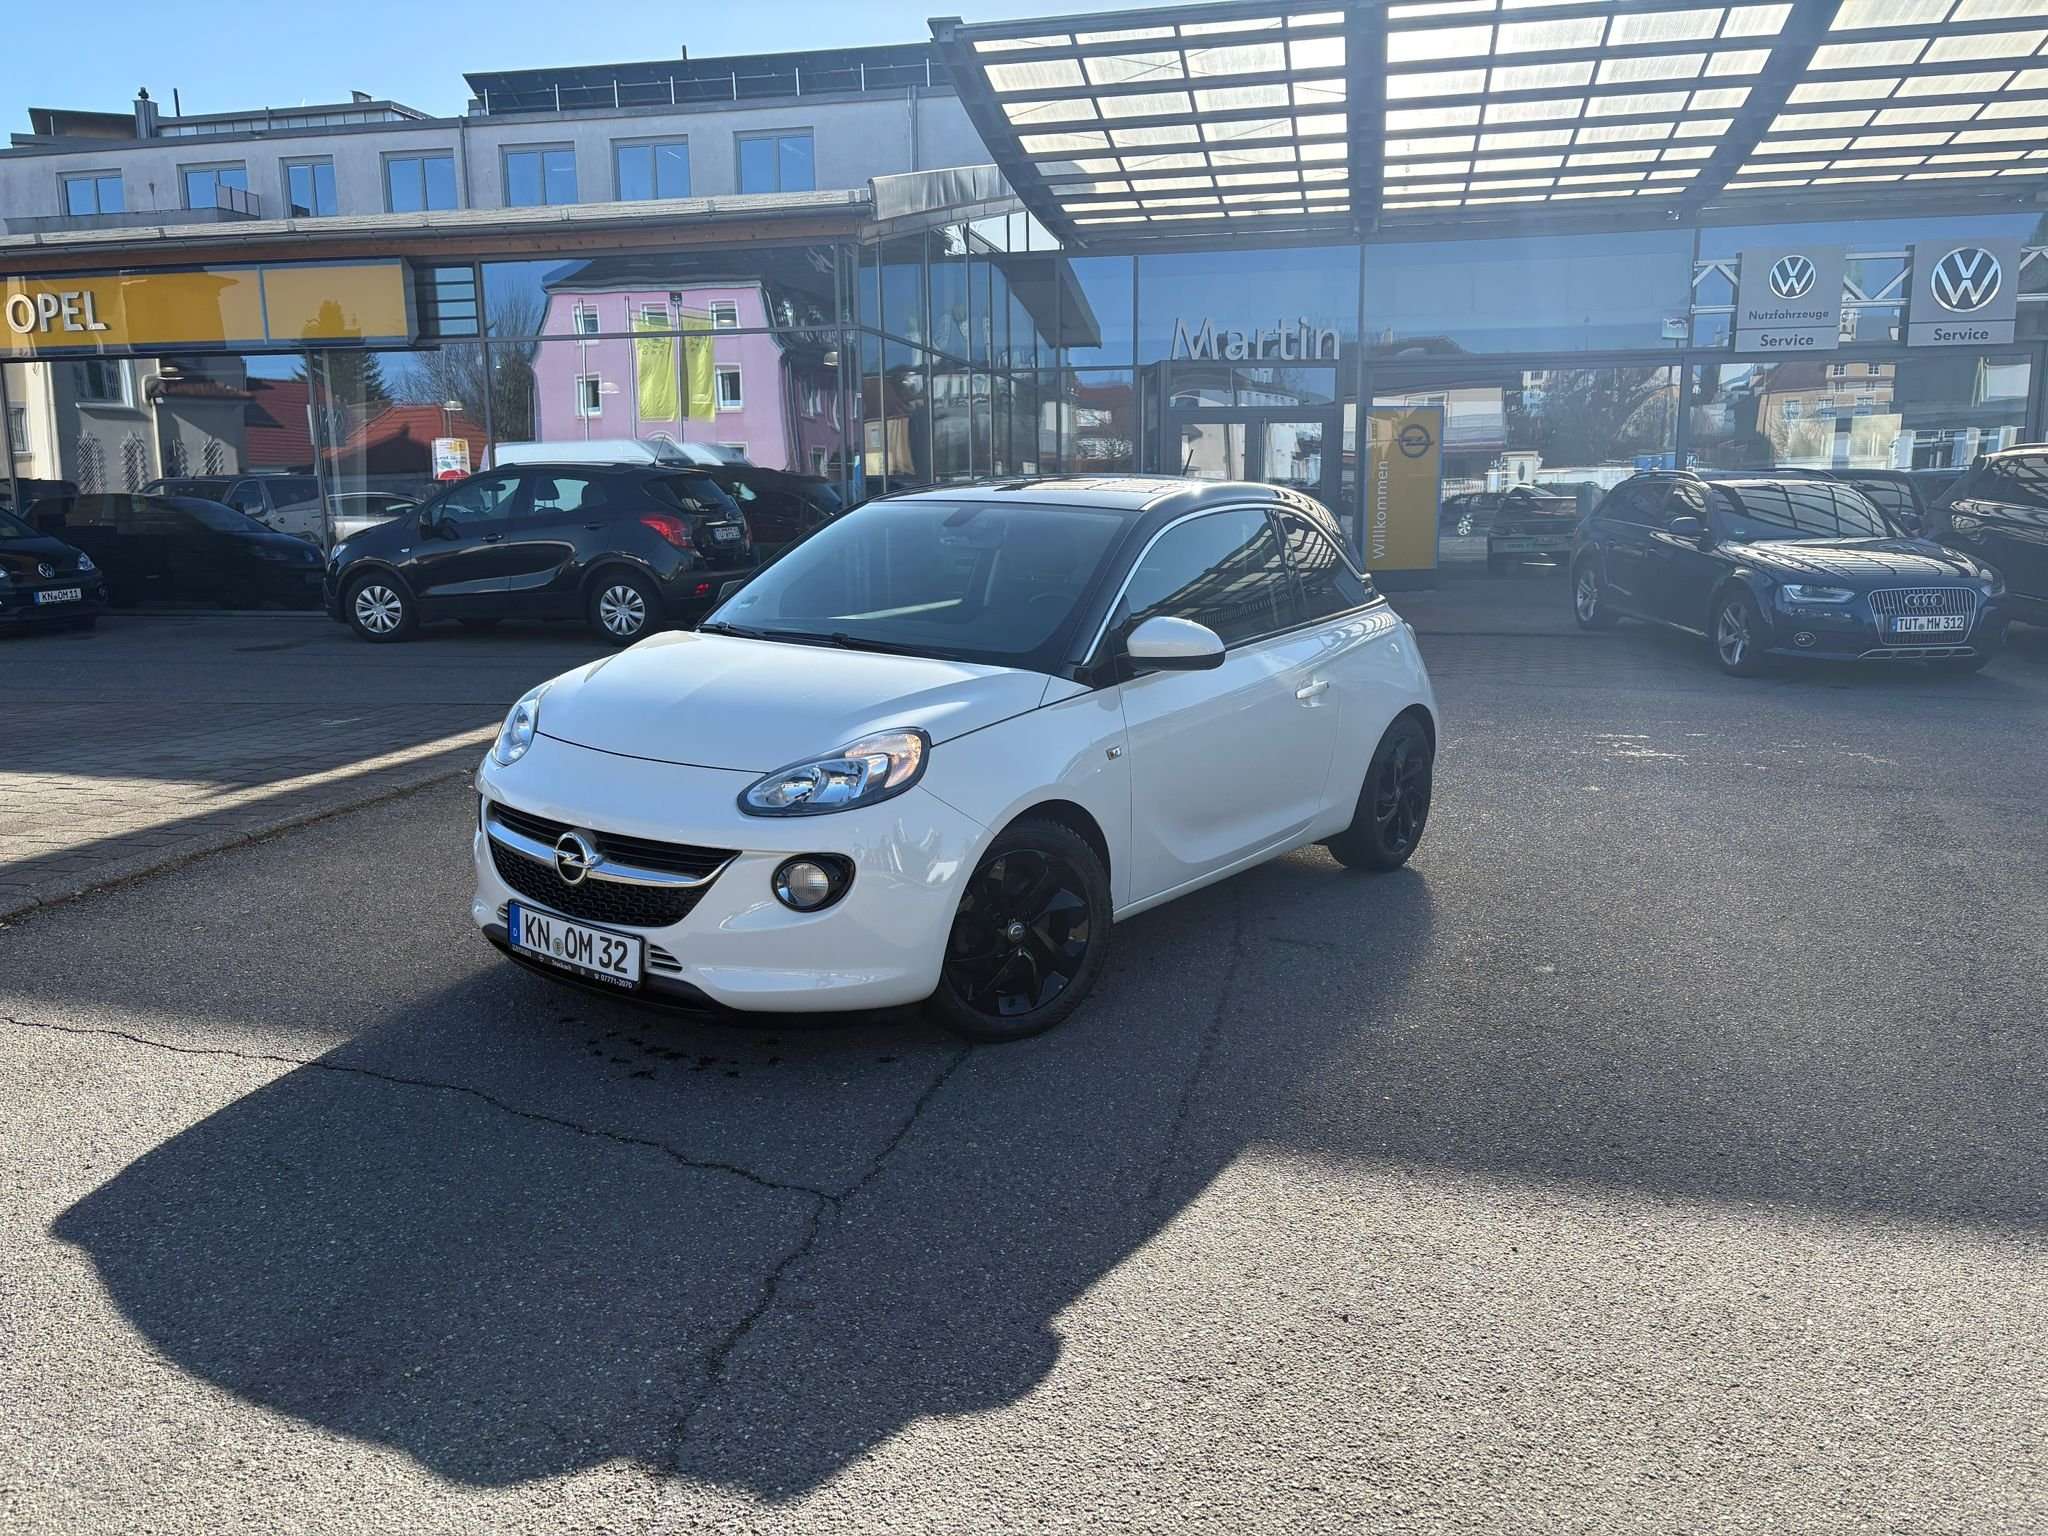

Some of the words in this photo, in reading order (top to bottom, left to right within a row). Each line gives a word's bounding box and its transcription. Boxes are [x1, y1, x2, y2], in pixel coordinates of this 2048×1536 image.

[6, 290, 108, 334] OPEL
[1748, 309, 1829, 321] Nutzfahrzeuge
[1171, 316, 1341, 360] Martin
[1760, 334, 1814, 347] Service
[1933, 327, 1989, 341] Service
[1372, 460, 1389, 560] Willkommen
[1898, 617, 1920, 631] TUT
[1943, 616, 1964, 630] 312
[525, 913, 551, 952] KN
[564, 926, 593, 965] OM
[599, 935, 628, 974] 32
